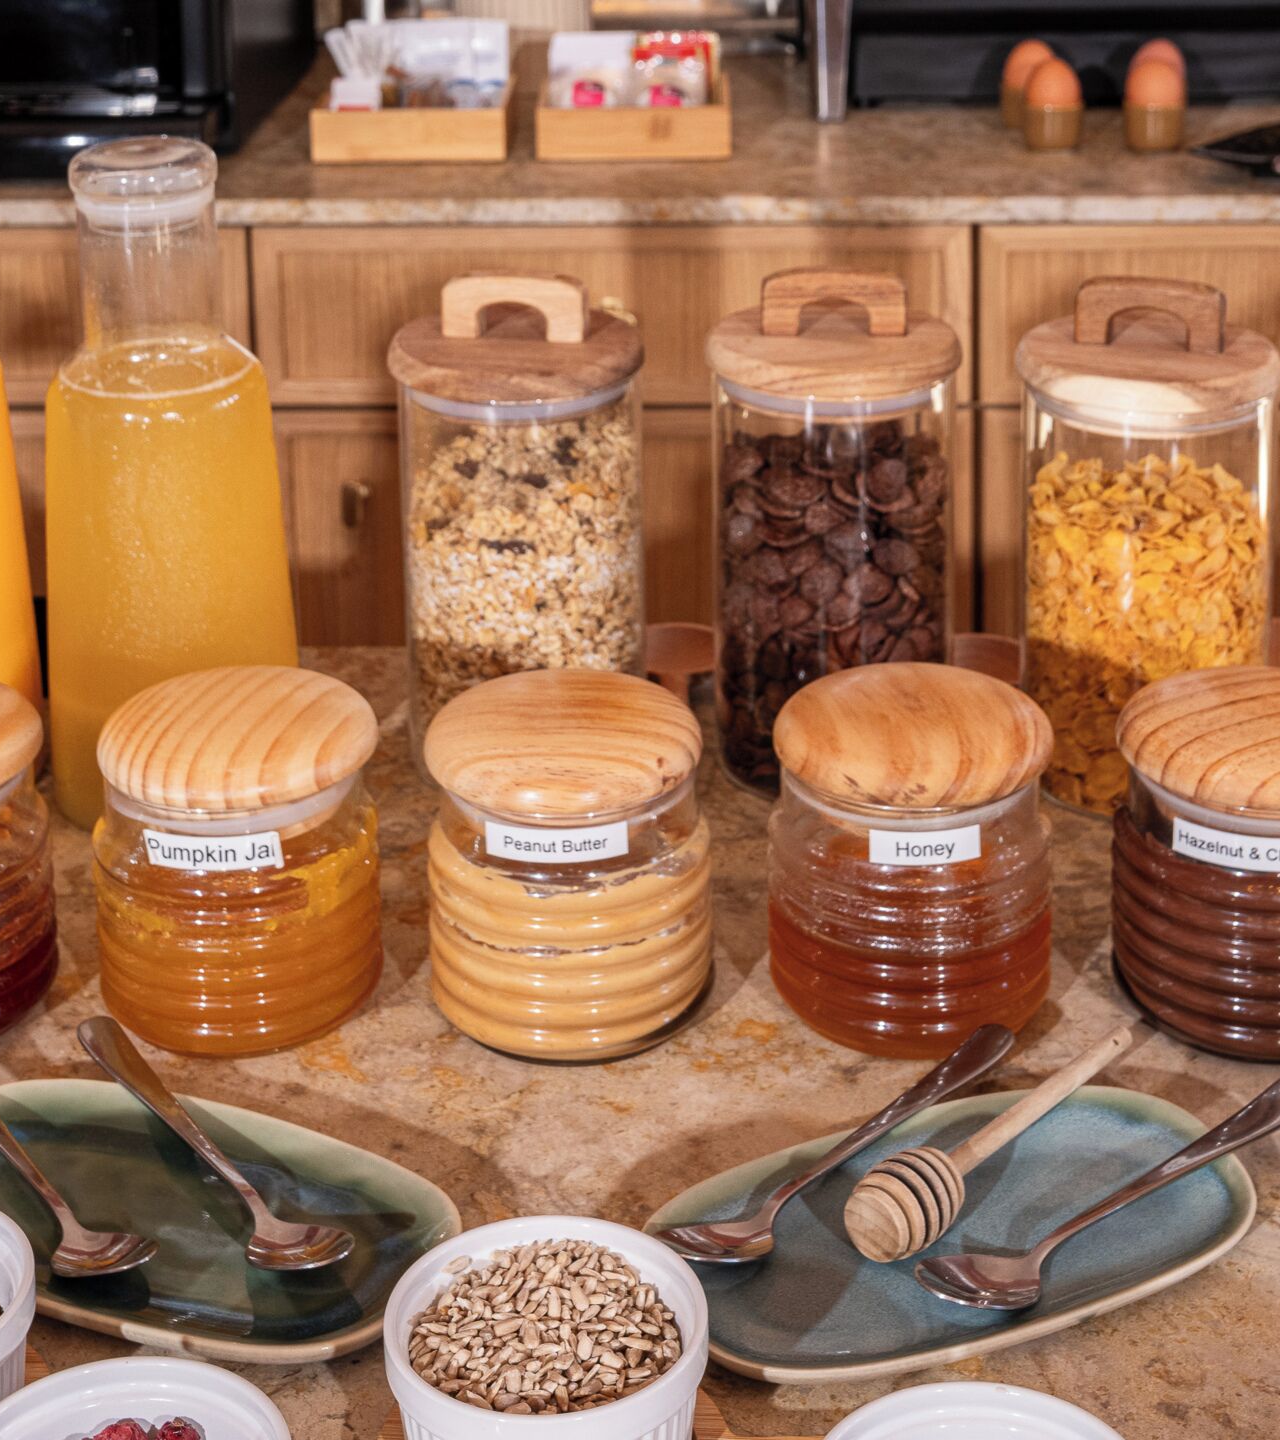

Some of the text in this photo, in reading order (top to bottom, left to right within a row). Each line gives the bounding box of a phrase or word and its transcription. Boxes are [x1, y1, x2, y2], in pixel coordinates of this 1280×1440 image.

[148, 838, 276, 866] Pumpkin Ja
[503, 836, 608, 853] Peanut Butter
[896, 842, 955, 859] Honey
[1178, 830, 1243, 859] Hazelnut
[1249, 847, 1260, 861] &
